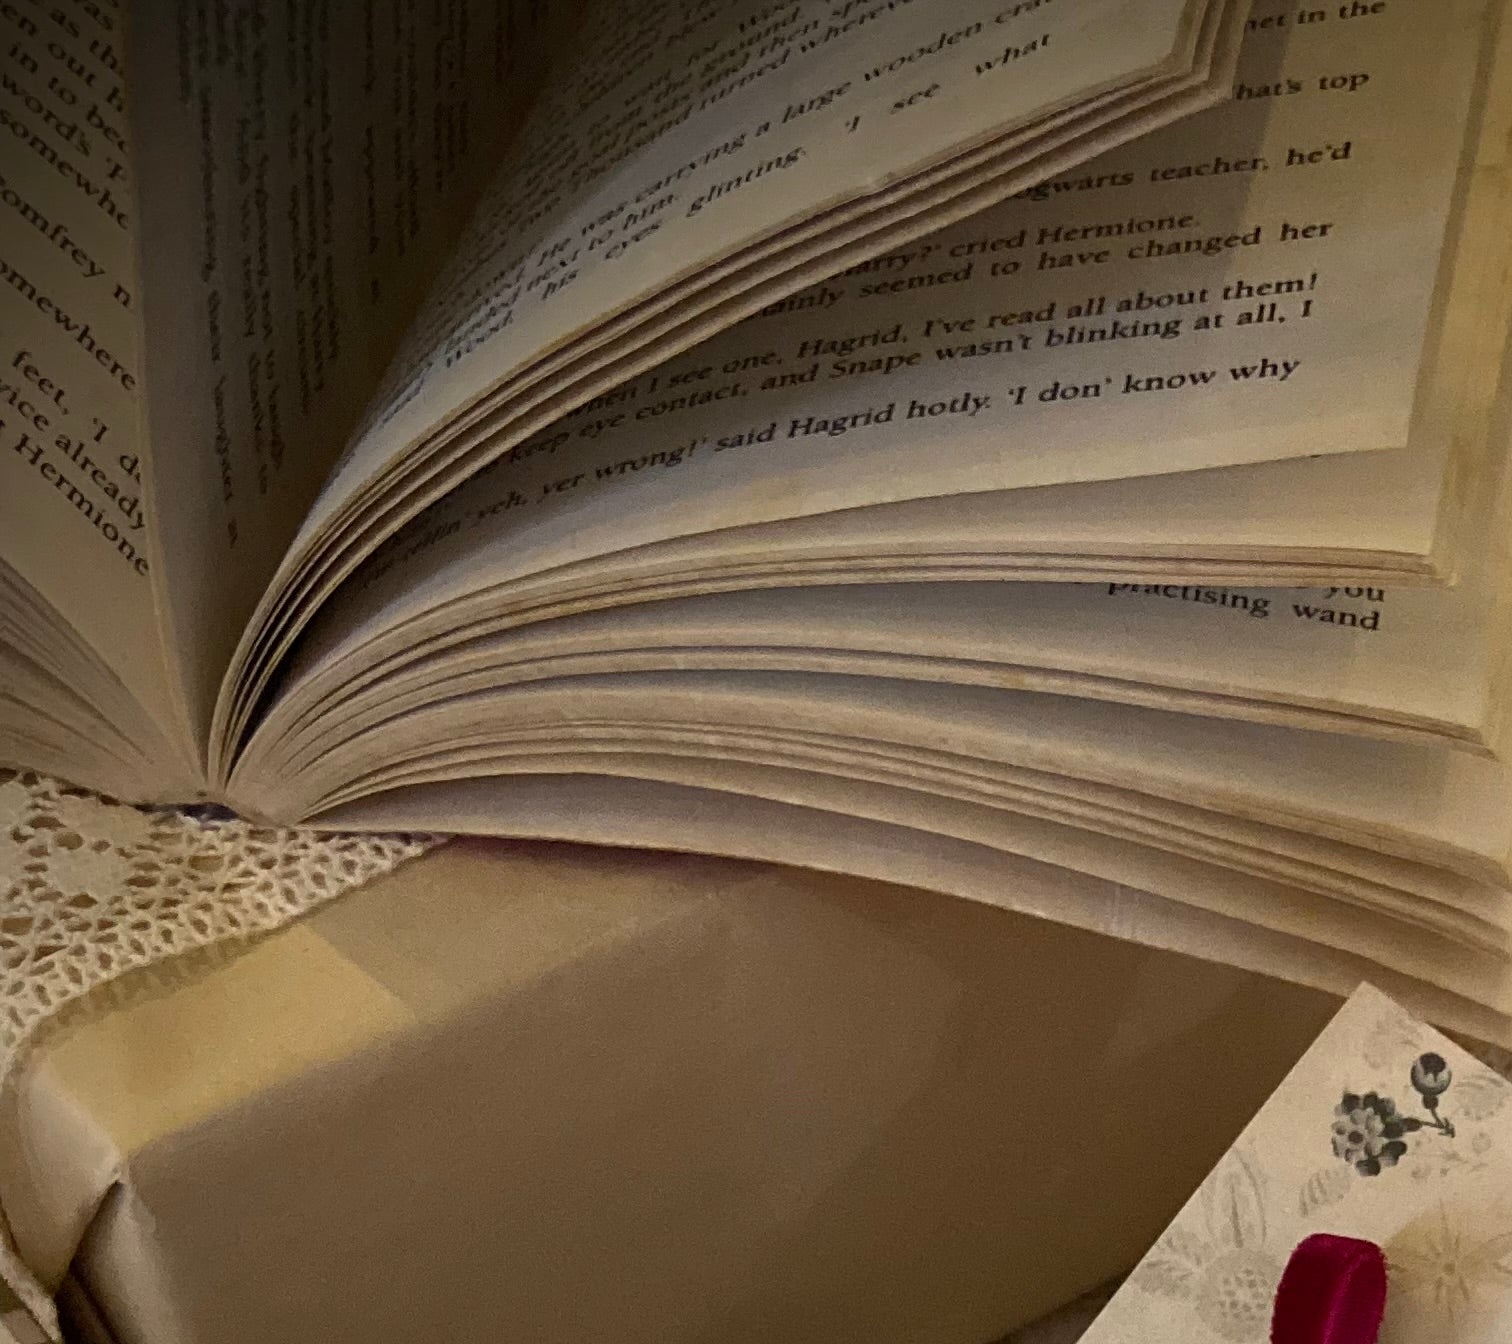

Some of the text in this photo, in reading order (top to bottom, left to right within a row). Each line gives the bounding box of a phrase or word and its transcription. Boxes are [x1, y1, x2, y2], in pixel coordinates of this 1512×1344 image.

[1297, 10, 1326, 25] in
[1338, 1, 1387, 20] the
[781, 81, 853, 124] large
[864, 20, 986, 82] wooden
[888, 82, 942, 114] see
[974, 33, 1050, 77] what
[1233, 72, 1371, 101] hat's top
[1150, 154, 1270, 183] teacher,
[1285, 141, 1353, 167] he'd
[0, 188, 105, 278] omfrey
[858, 262, 975, 298] seemed
[989, 261, 1022, 277] to
[1036, 249, 1111, 272] have
[1127, 225, 1263, 260] changed
[1279, 219, 1336, 242] her
[949, 228, 1027, 258] cried
[1036, 212, 1201, 246] Hermione.
[0, 257, 136, 391] mewhere
[667, 366, 713, 389] see
[721, 350, 783, 375] one,
[796, 323, 909, 360] Hagrid,
[921, 317, 977, 339] I've
[986, 301, 1057, 330] read
[1065, 296, 1106, 320] all
[1115, 288, 1209, 313] about
[1221, 272, 1319, 302] them!
[759, 362, 819, 391] and
[828, 352, 922, 379] Snape
[935, 333, 1033, 360] wasn't
[1044, 317, 1184, 350] blinking
[1192, 311, 1226, 332] at
[1235, 302, 1287, 326] all,
[1300, 299, 1313, 319] I
[595, 436, 708, 480] wrong!'
[714, 422, 778, 452] said
[787, 401, 897, 438] Hagrid
[905, 391, 992, 420] hotly.
[1121, 369, 1218, 394] know
[1228, 357, 1303, 382] why
[14, 433, 149, 576] Hermione
[54, 433, 145, 530] already
[1291, 603, 1381, 631] wand
